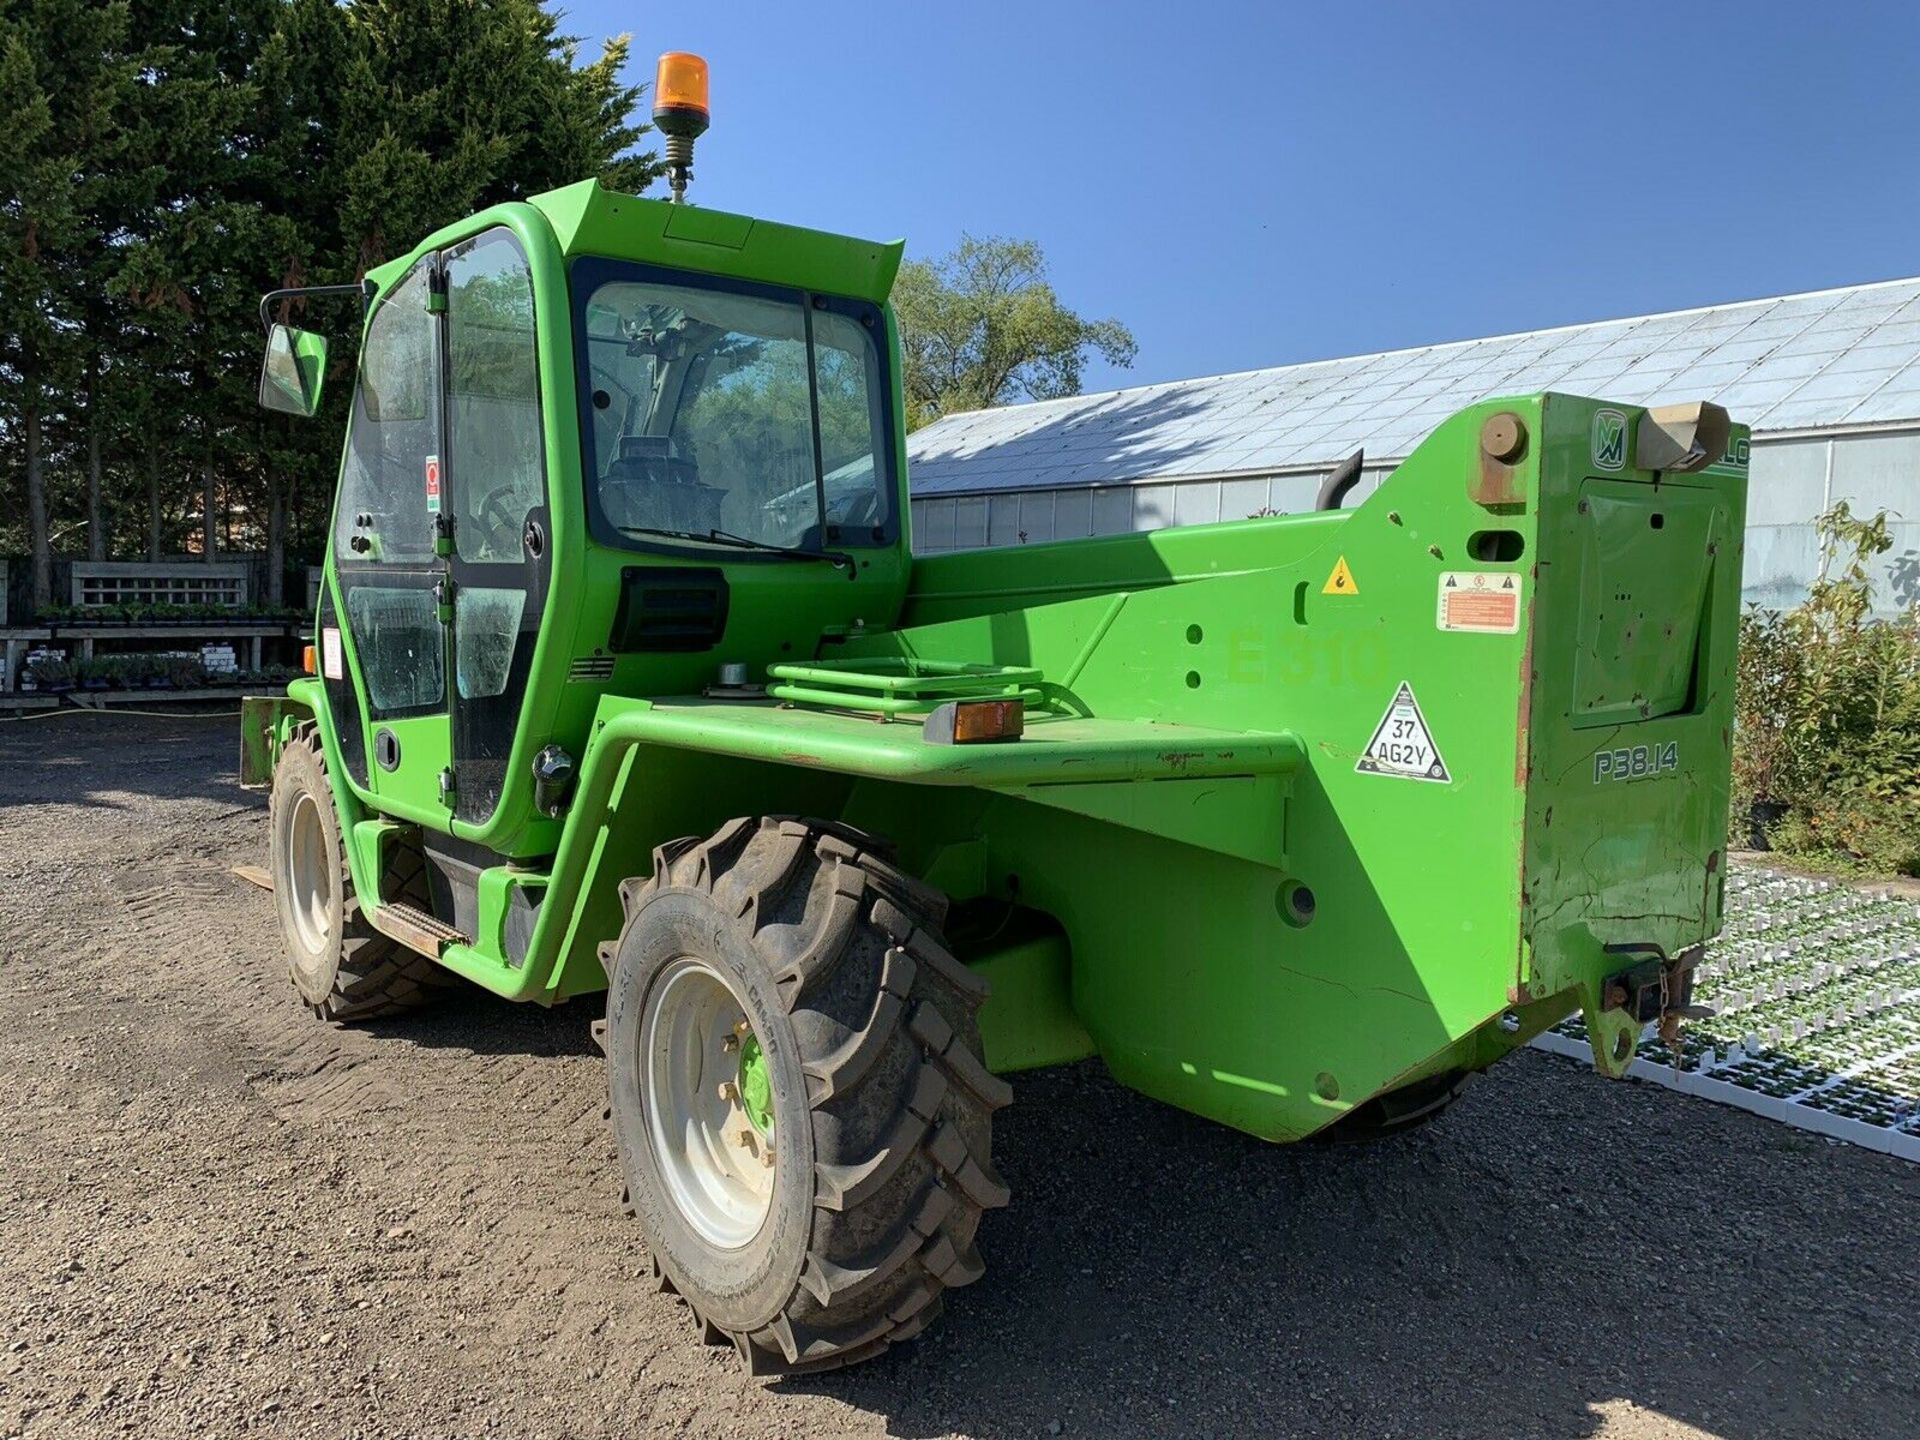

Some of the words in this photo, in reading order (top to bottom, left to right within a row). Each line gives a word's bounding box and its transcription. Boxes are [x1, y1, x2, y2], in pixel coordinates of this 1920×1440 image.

[1392, 719, 1416, 739] 37
[1378, 742, 1427, 766] AG2Y
[1593, 741, 1679, 785] P38.14
